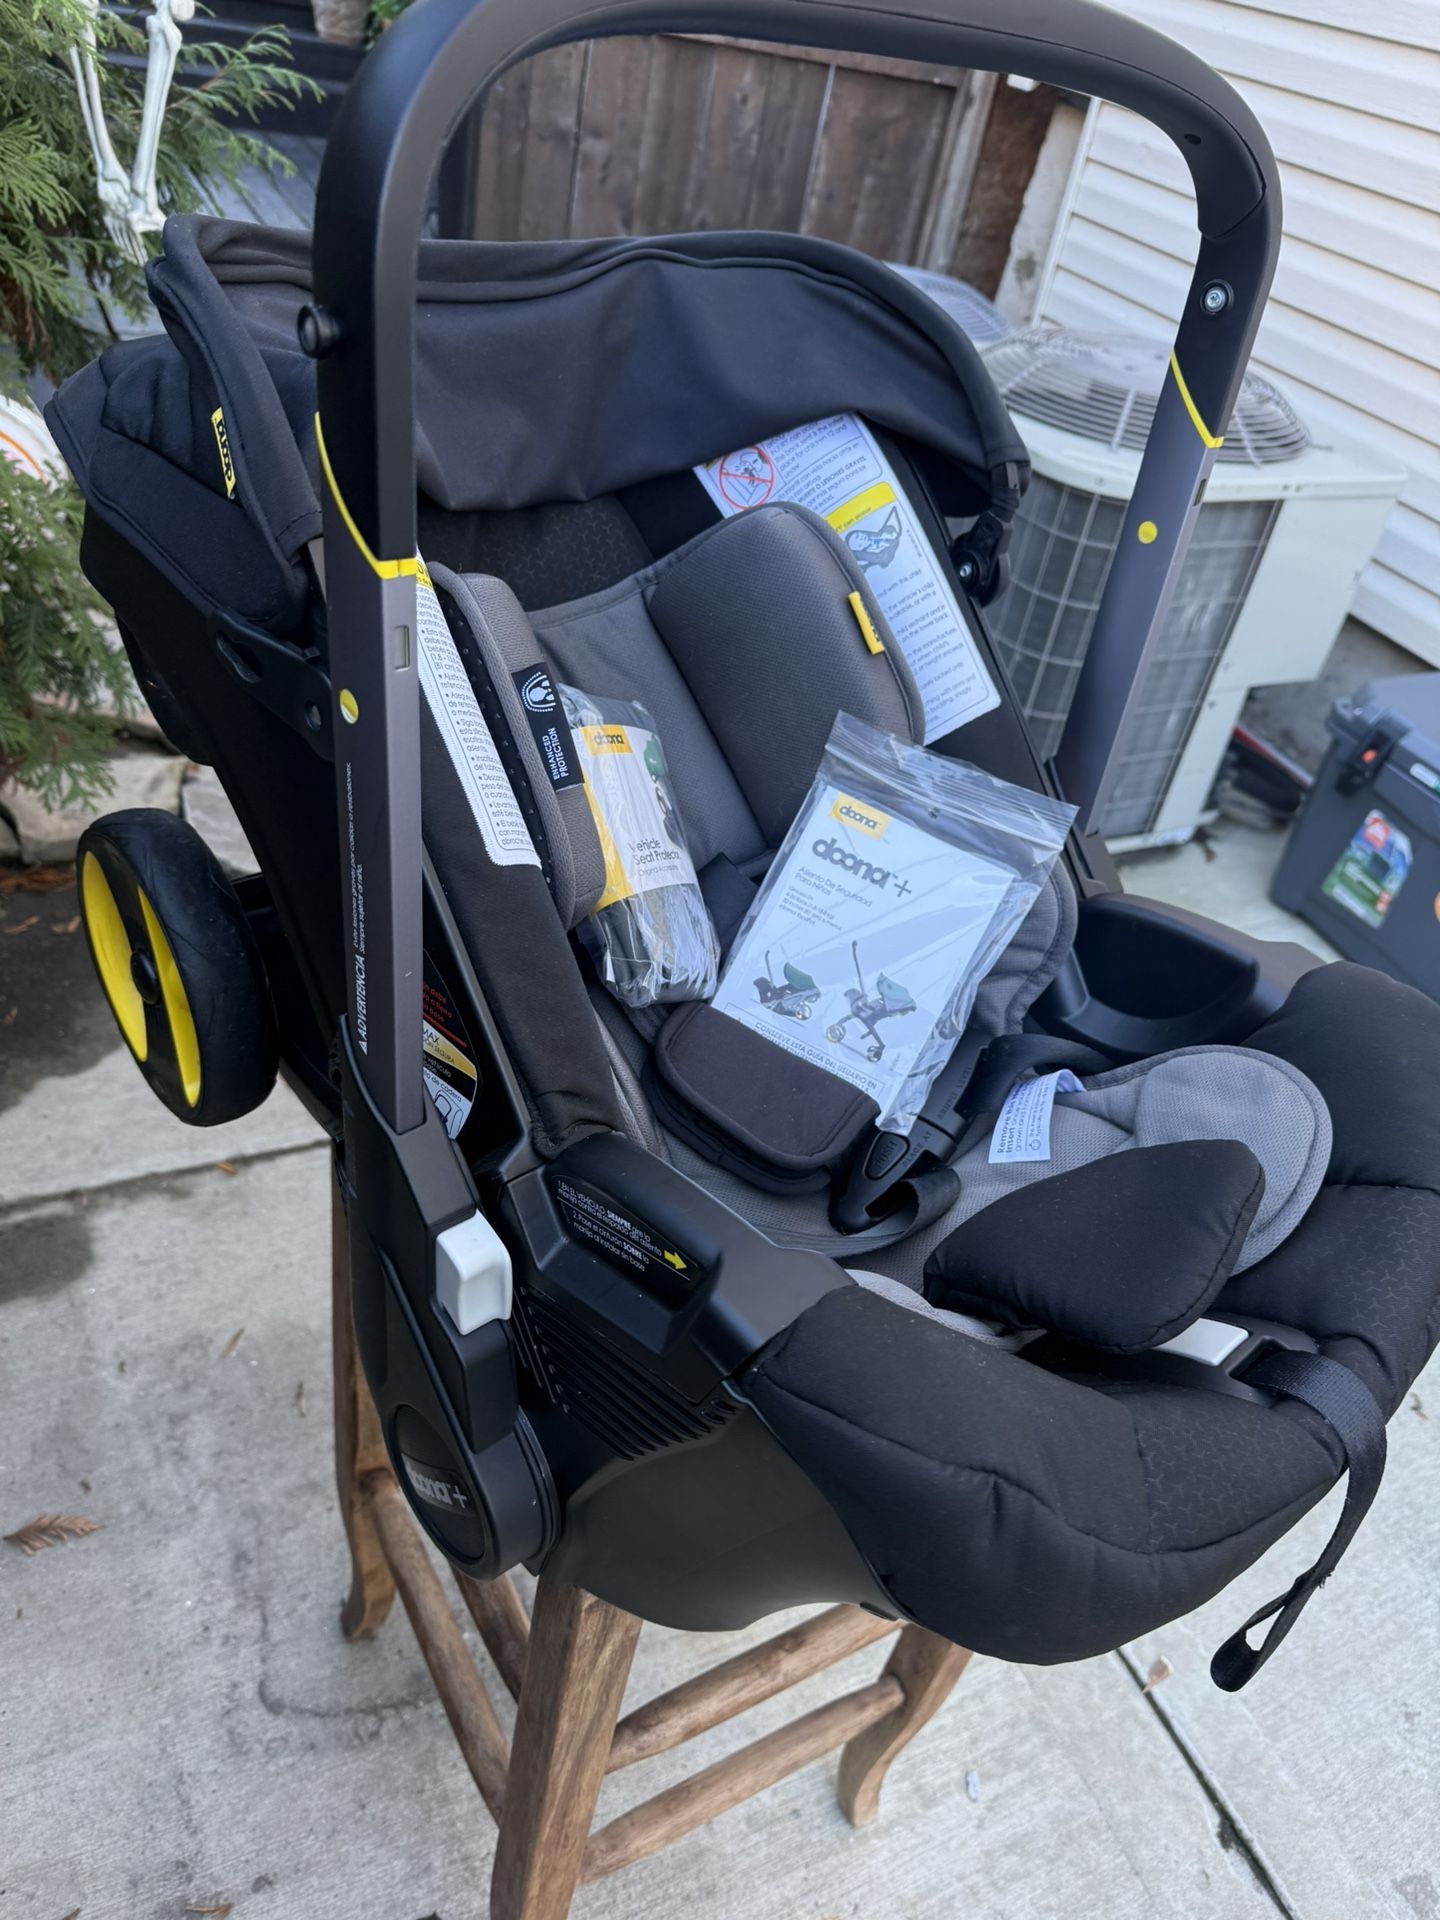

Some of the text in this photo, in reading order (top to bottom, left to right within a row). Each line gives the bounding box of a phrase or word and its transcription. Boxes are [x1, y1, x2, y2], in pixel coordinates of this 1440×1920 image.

[541, 734, 560, 780] ENHANCED
[547, 726, 569, 777] PROTECTION
[840, 805, 876, 830] doona
[634, 855, 655, 865] Seat
[794, 871, 813, 886] Para
[357, 921, 366, 954] Siempre
[355, 954, 367, 1040] ADVERTENCIA
[753, 1021, 792, 1045] CONSERVE
[789, 1039, 807, 1053] ESTA
[824, 1058, 837, 1069] DEL
[836, 1064, 868, 1084] USUARIO
[865, 1079, 877, 1089] EN
[920, 1129, 932, 1142] AT
[994, 1115, 1014, 1153] Remove
[557, 1187, 578, 1204] manija
[577, 1200, 596, 1215] contra
[601, 1214, 628, 1234] respaldo
[638, 1237, 662, 1256] asiento
[606, 1209, 631, 1229] SIEMPRE
[573, 1221, 593, 1238] manija
[628, 1256, 645, 1272] base
[622, 1241, 642, 1259] SOBRE
